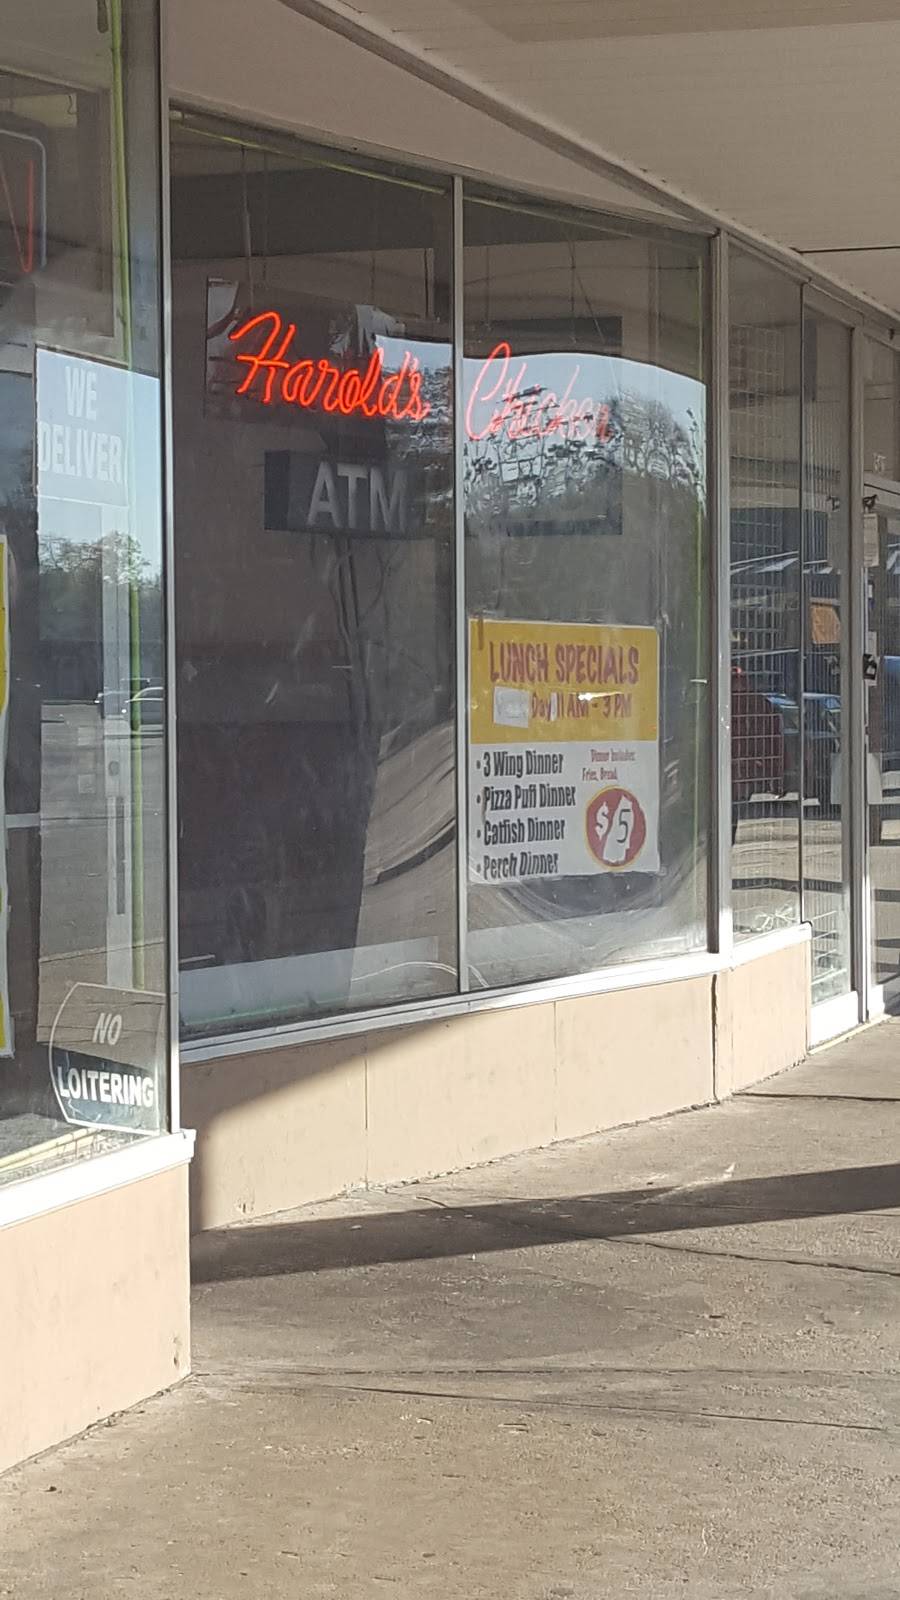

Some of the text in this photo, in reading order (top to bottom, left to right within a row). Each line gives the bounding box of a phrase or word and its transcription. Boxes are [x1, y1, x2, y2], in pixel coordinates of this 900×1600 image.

[230, 311, 430, 421] Harold's
[65, 366, 97, 420] WE
[38, 421, 123, 484] DELIVER
[306, 461, 408, 533] ATM
[489, 641, 639, 685] LUNCH SPECIALS
[567, 693, 590, 718] AM
[603, 695, 611, 718] 3
[614, 692, 632, 718] PM
[483, 750, 564, 778] 3 Wing Dinner
[484, 783, 576, 812] Pizza Puff Dinner
[484, 817, 565, 845] Catfish Dinner
[483, 852, 559, 880] Perch Dinner
[92, 1012, 123, 1046] NO
[57, 1066, 154, 1108] LOITERING
